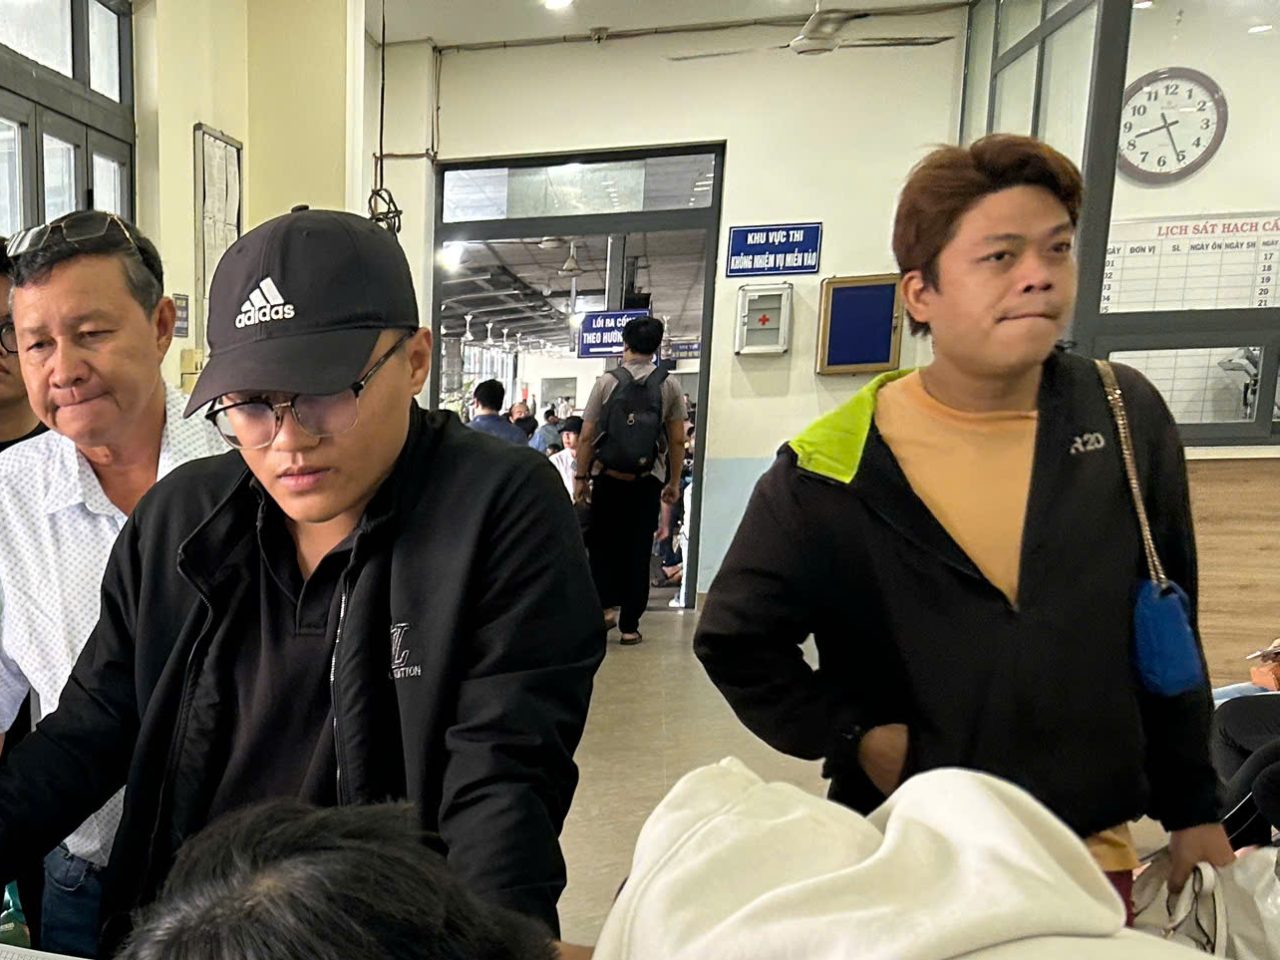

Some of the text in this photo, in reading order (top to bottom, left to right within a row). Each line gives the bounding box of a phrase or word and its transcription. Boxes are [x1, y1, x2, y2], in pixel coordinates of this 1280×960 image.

[1163, 84, 1179, 95] 12
[1186, 88, 1193, 99] 1
[1146, 90, 1158, 101] 11
[1131, 105, 1147, 116] 10
[1197, 101, 1206, 111] 2
[1123, 122, 1132, 133] 9
[1200, 118, 1210, 130] 3
[1127, 140, 1136, 151] 8
[1192, 137, 1201, 148] 4
[1140, 152, 1149, 162] 7
[1157, 156, 1166, 167] 6
[1157, 225, 1188, 239] LỊCH
[1192, 221, 1218, 235] SÁT
[1221, 222, 1258, 237] HẠCH
[747, 230, 804, 245] KHU VỰC THI
[731, 252, 752, 269] KHÔNG
[235, 303, 295, 328] adidas
[606, 318, 615, 328] RA
[583, 333, 601, 344] THEO
